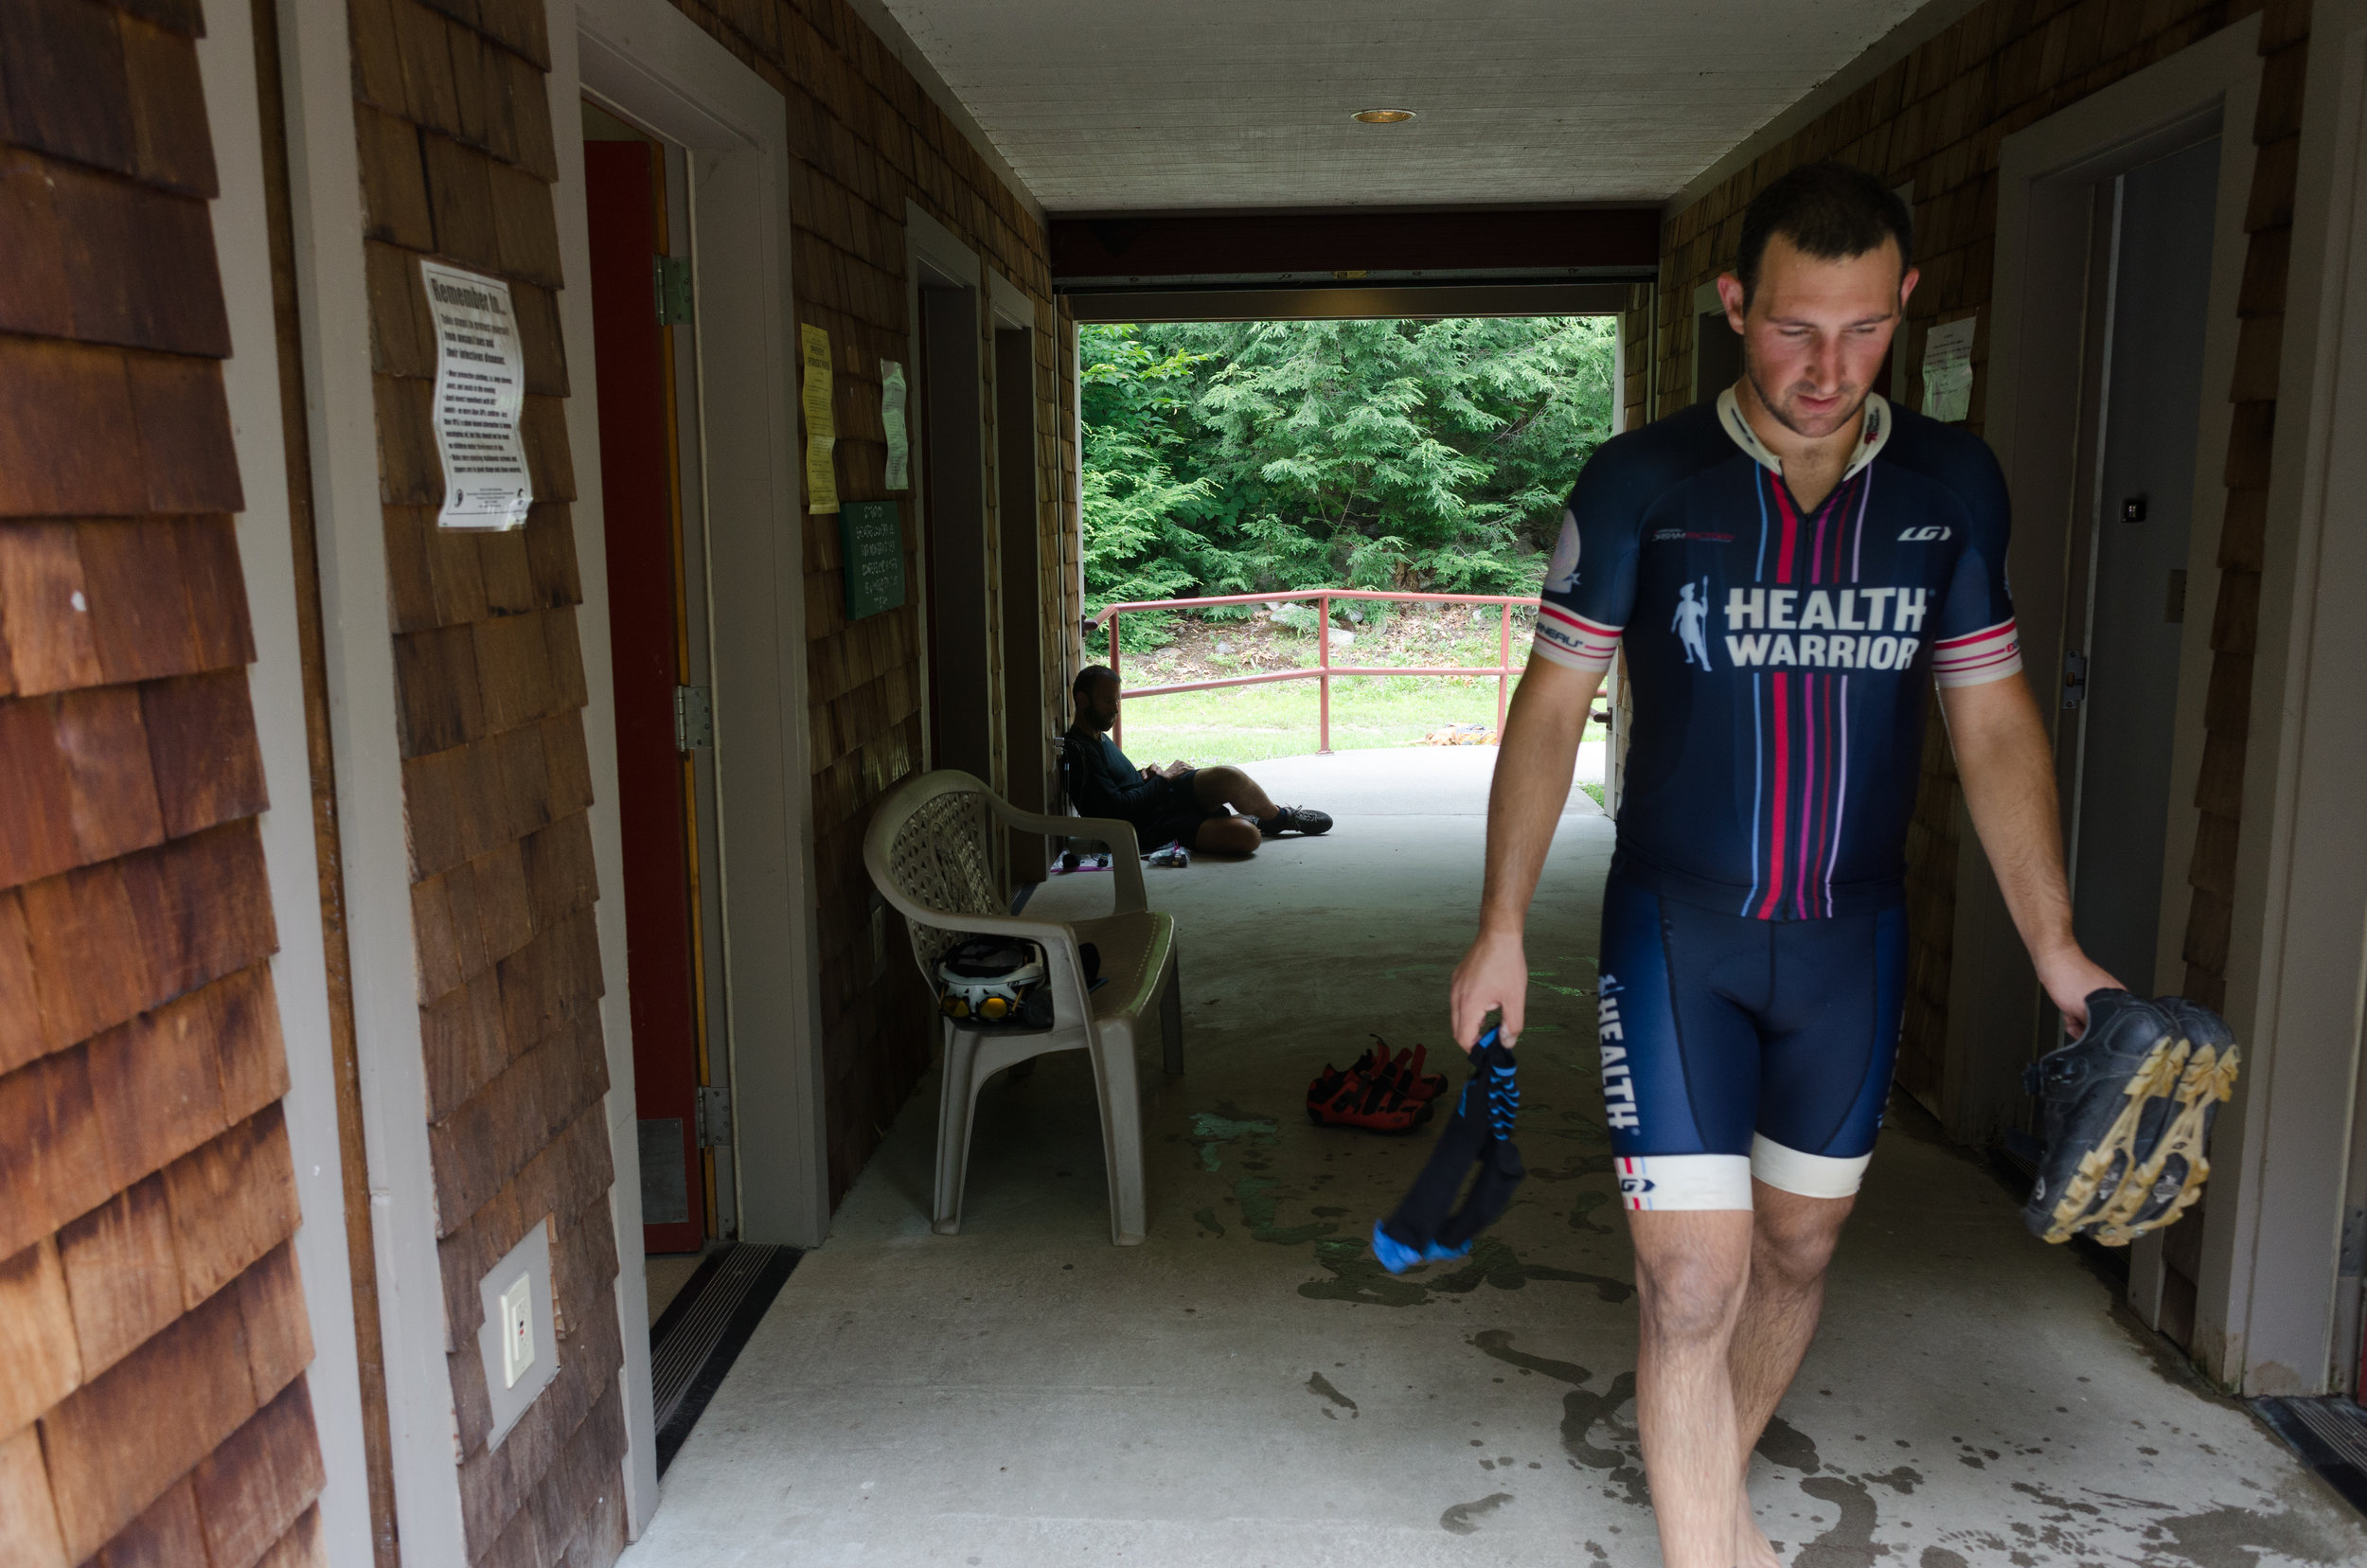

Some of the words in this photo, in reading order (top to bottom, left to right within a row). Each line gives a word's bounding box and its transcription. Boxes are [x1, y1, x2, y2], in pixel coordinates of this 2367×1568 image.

[432, 278, 489, 312] Remember
[1724, 586, 1928, 633] HEALTH
[1724, 633, 1920, 670] WARRIOR
[1597, 997, 1641, 1130] HEALTH
